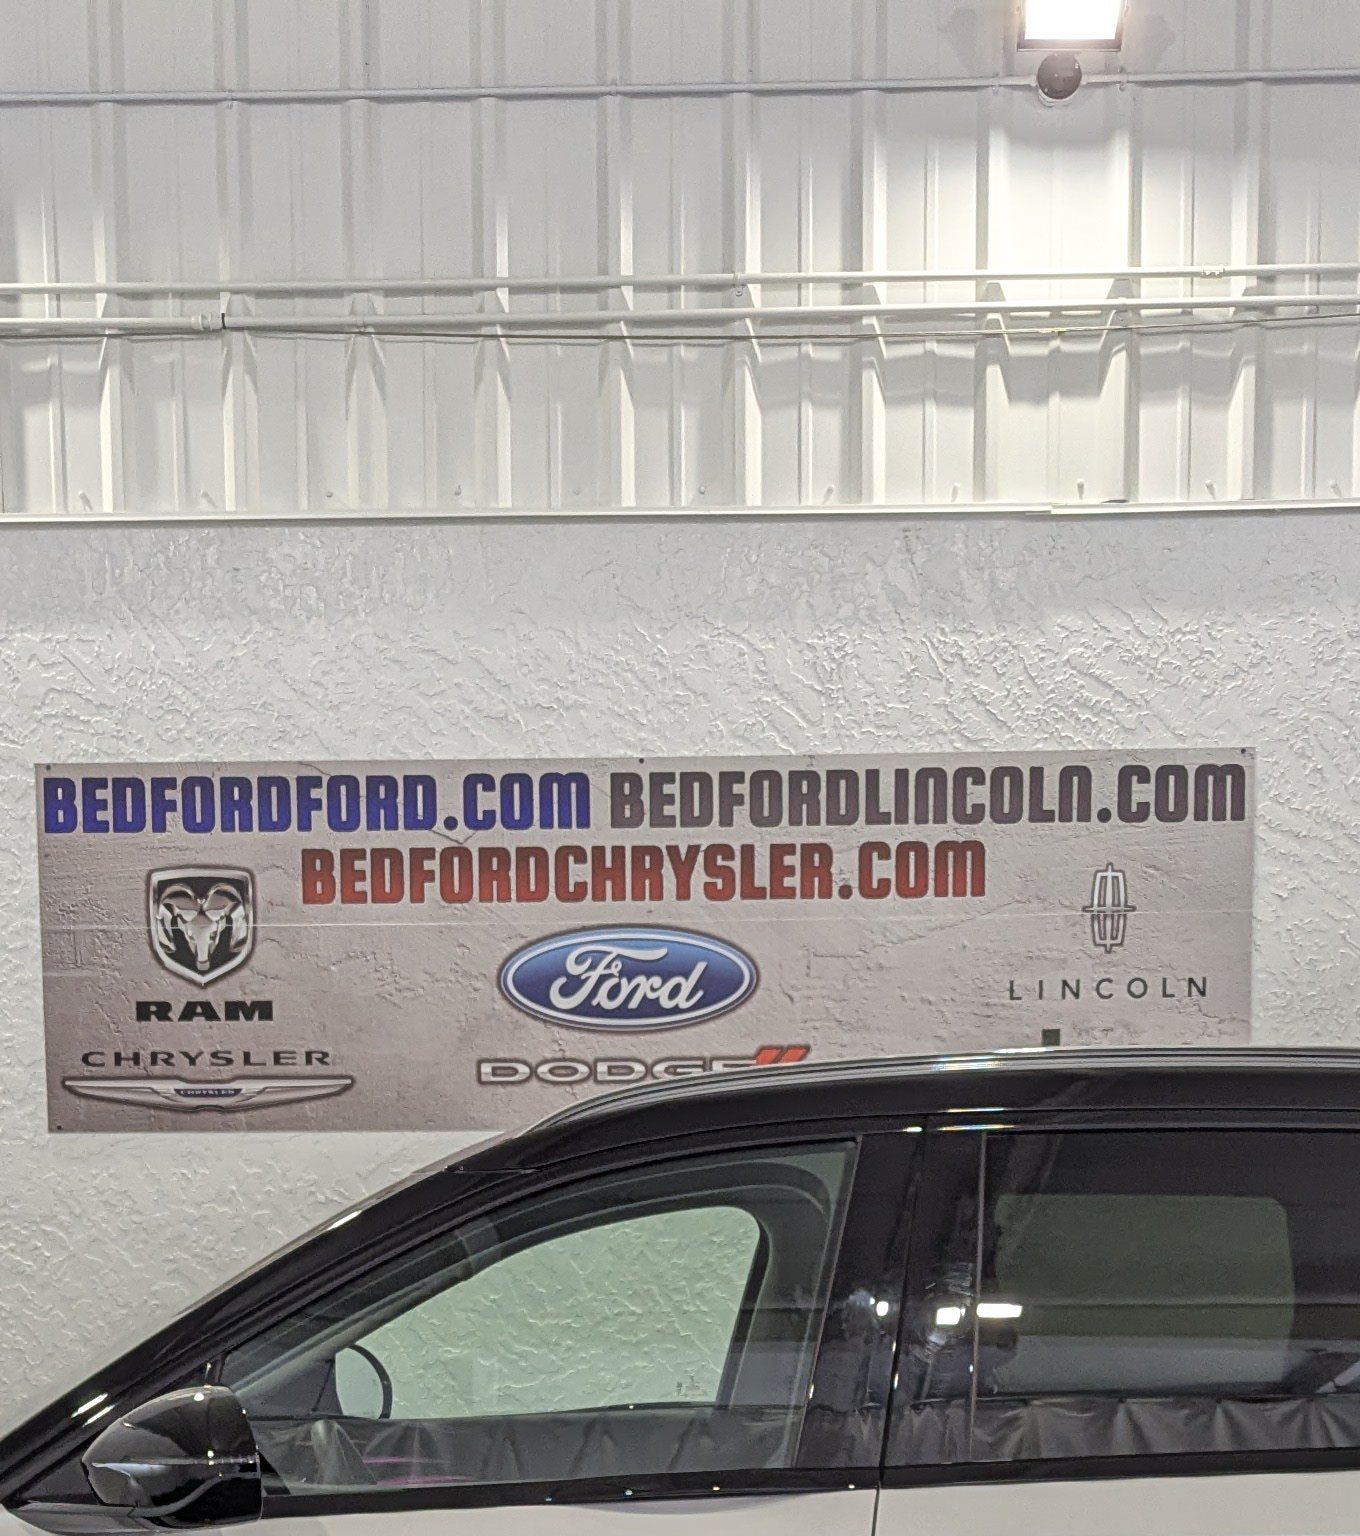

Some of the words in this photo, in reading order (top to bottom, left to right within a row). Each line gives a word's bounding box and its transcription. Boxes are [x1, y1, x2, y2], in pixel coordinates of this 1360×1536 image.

[44, 772, 590, 834] BEDFORDFORD.COM
[610, 763, 1247, 829] BEDFORDLINCOLN.COM
[301, 840, 986, 905] BEDFORDCHRYSLER.COM
[549, 945, 708, 1010] Ford
[1008, 976, 1208, 1001] LINCOLN
[135, 1000, 273, 1022] RAM
[81, 1050, 331, 1068] CHRYSLER
